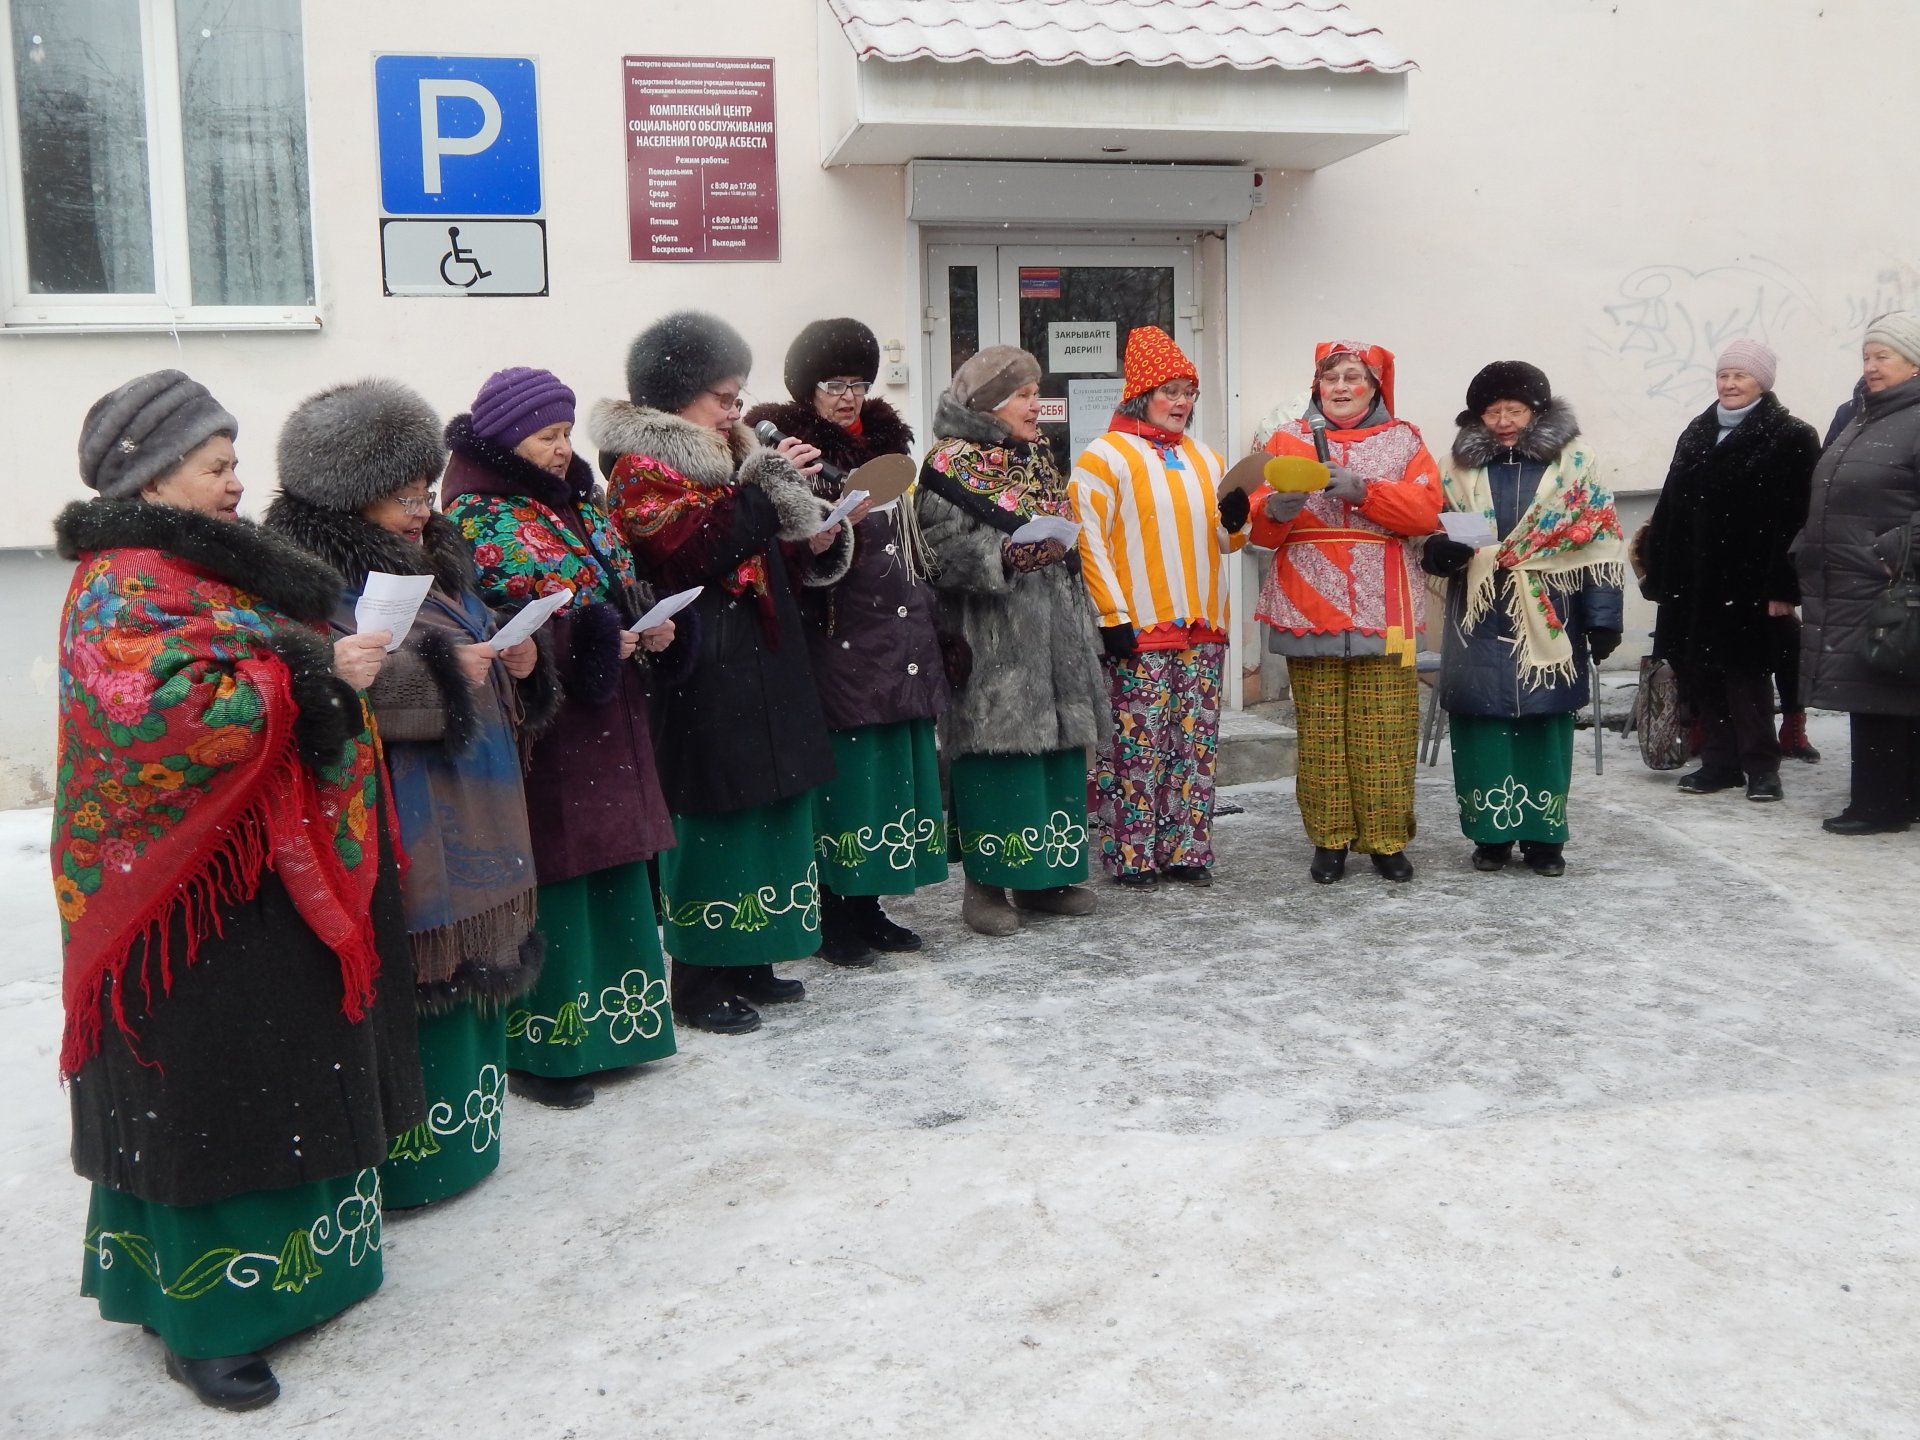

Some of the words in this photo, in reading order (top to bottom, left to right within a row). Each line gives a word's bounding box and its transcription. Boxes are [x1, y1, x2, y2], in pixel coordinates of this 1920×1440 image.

[626, 60, 661, 68] Министерство
[631, 78, 674, 86] Государственное
[674, 78, 703, 86] бюджетное
[640, 87, 677, 95] обслуживания
[650, 103, 721, 116] КОМПЛЕКСНЫЙ
[723, 105, 752, 118] ЦЕНТР
[629, 120, 697, 133] СОЦИАЛЬНОГО
[698, 121, 773, 133] ОБСЛУЖИВАНИЯ
[419, 79, 502, 194] P
[636, 135, 690, 147] НАСЕЛЕНИЯ
[692, 136, 728, 149] ГОРОДА
[729, 136, 767, 148] АСБЕСТА
[675, 156, 700, 164] Режим
[700, 157, 730, 165] работы:
[648, 168, 693, 176] Понедельник
[649, 179, 677, 187] Вторник
[714, 182, 729, 190] 8:00
[739, 182, 757, 190] 17:00
[649, 190, 670, 198] Среда
[649, 201, 677, 209] Четверг
[650, 218, 679, 226] Пятница
[715, 216, 731, 224] 8:00
[740, 216, 758, 224] 16:00
[651, 235, 679, 243] Суббота
[712, 239, 746, 248] Выходной
[651, 246, 694, 254] Воскресенье
[1055, 329, 1111, 339] ЗАКРЫВАЙТЕ
[1064, 346, 1102, 355] ДВЕРИ!!!
[1040, 404, 1064, 416] СЕБЯ
